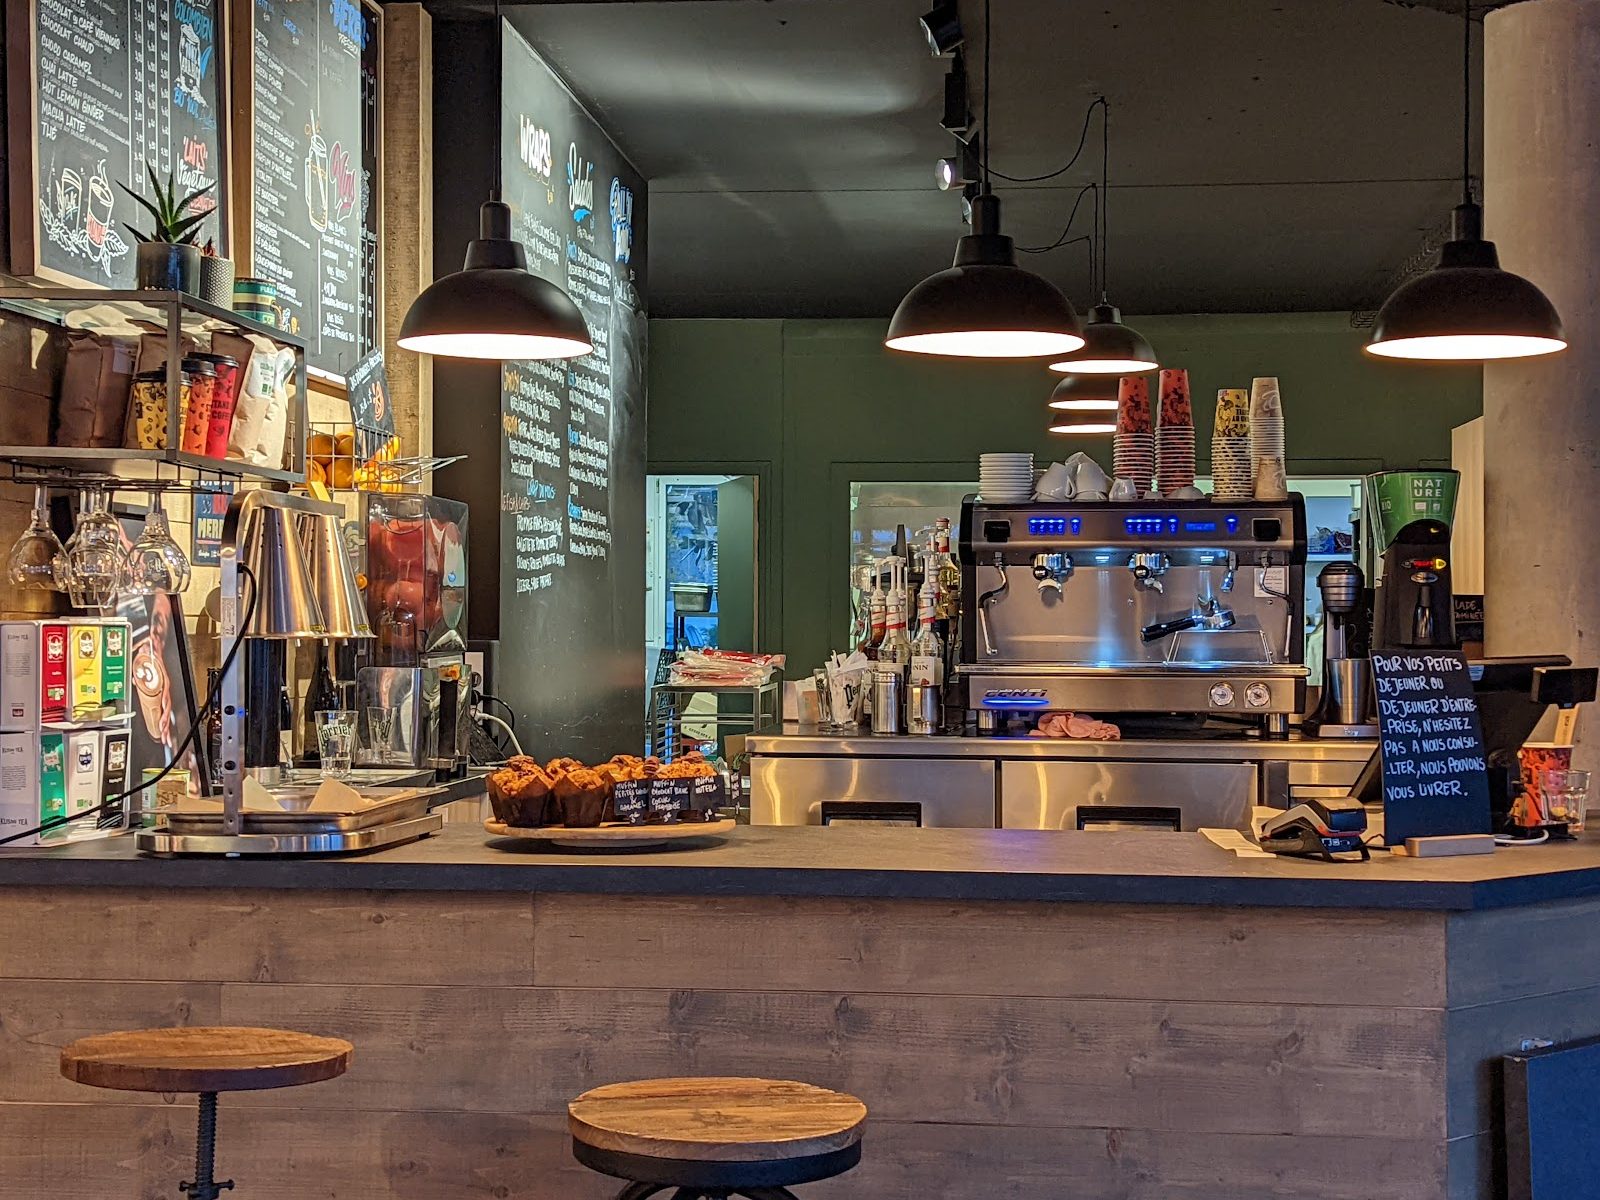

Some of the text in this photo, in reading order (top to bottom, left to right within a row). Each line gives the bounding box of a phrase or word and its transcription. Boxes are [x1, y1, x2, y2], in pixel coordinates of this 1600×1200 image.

[41, 13, 94, 54] CHOCOLAT CHAUD
[41, 34, 92, 75] CHOCO CARAMEL
[58, 68, 78, 88] LATTE
[42, 78, 56, 96] HOT
[56, 88, 80, 110] LEMON
[42, 100, 64, 124] MACHA
[66, 114, 87, 133] LATTE
[520, 113, 551, 178] WRAPS
[1414, 479, 1442, 488] NAT
[1414, 489, 1442, 497] URE
[1372, 655, 1462, 674] POUR VOS PETITS
[1376, 676, 1444, 696] DEJEUNER OU
[1379, 695, 1478, 718] DEJEUNER D'ENTRE-
[1422, 717, 1472, 733] N'HESITEZ
[1384, 736, 1479, 758] PAS A NOUS CONSU-
[1421, 760, 1446, 775] NOUS
[1448, 756, 1486, 774] POUVONS
[653, 779, 676, 788] MUFFIN
[1386, 786, 1416, 802] VOUS
